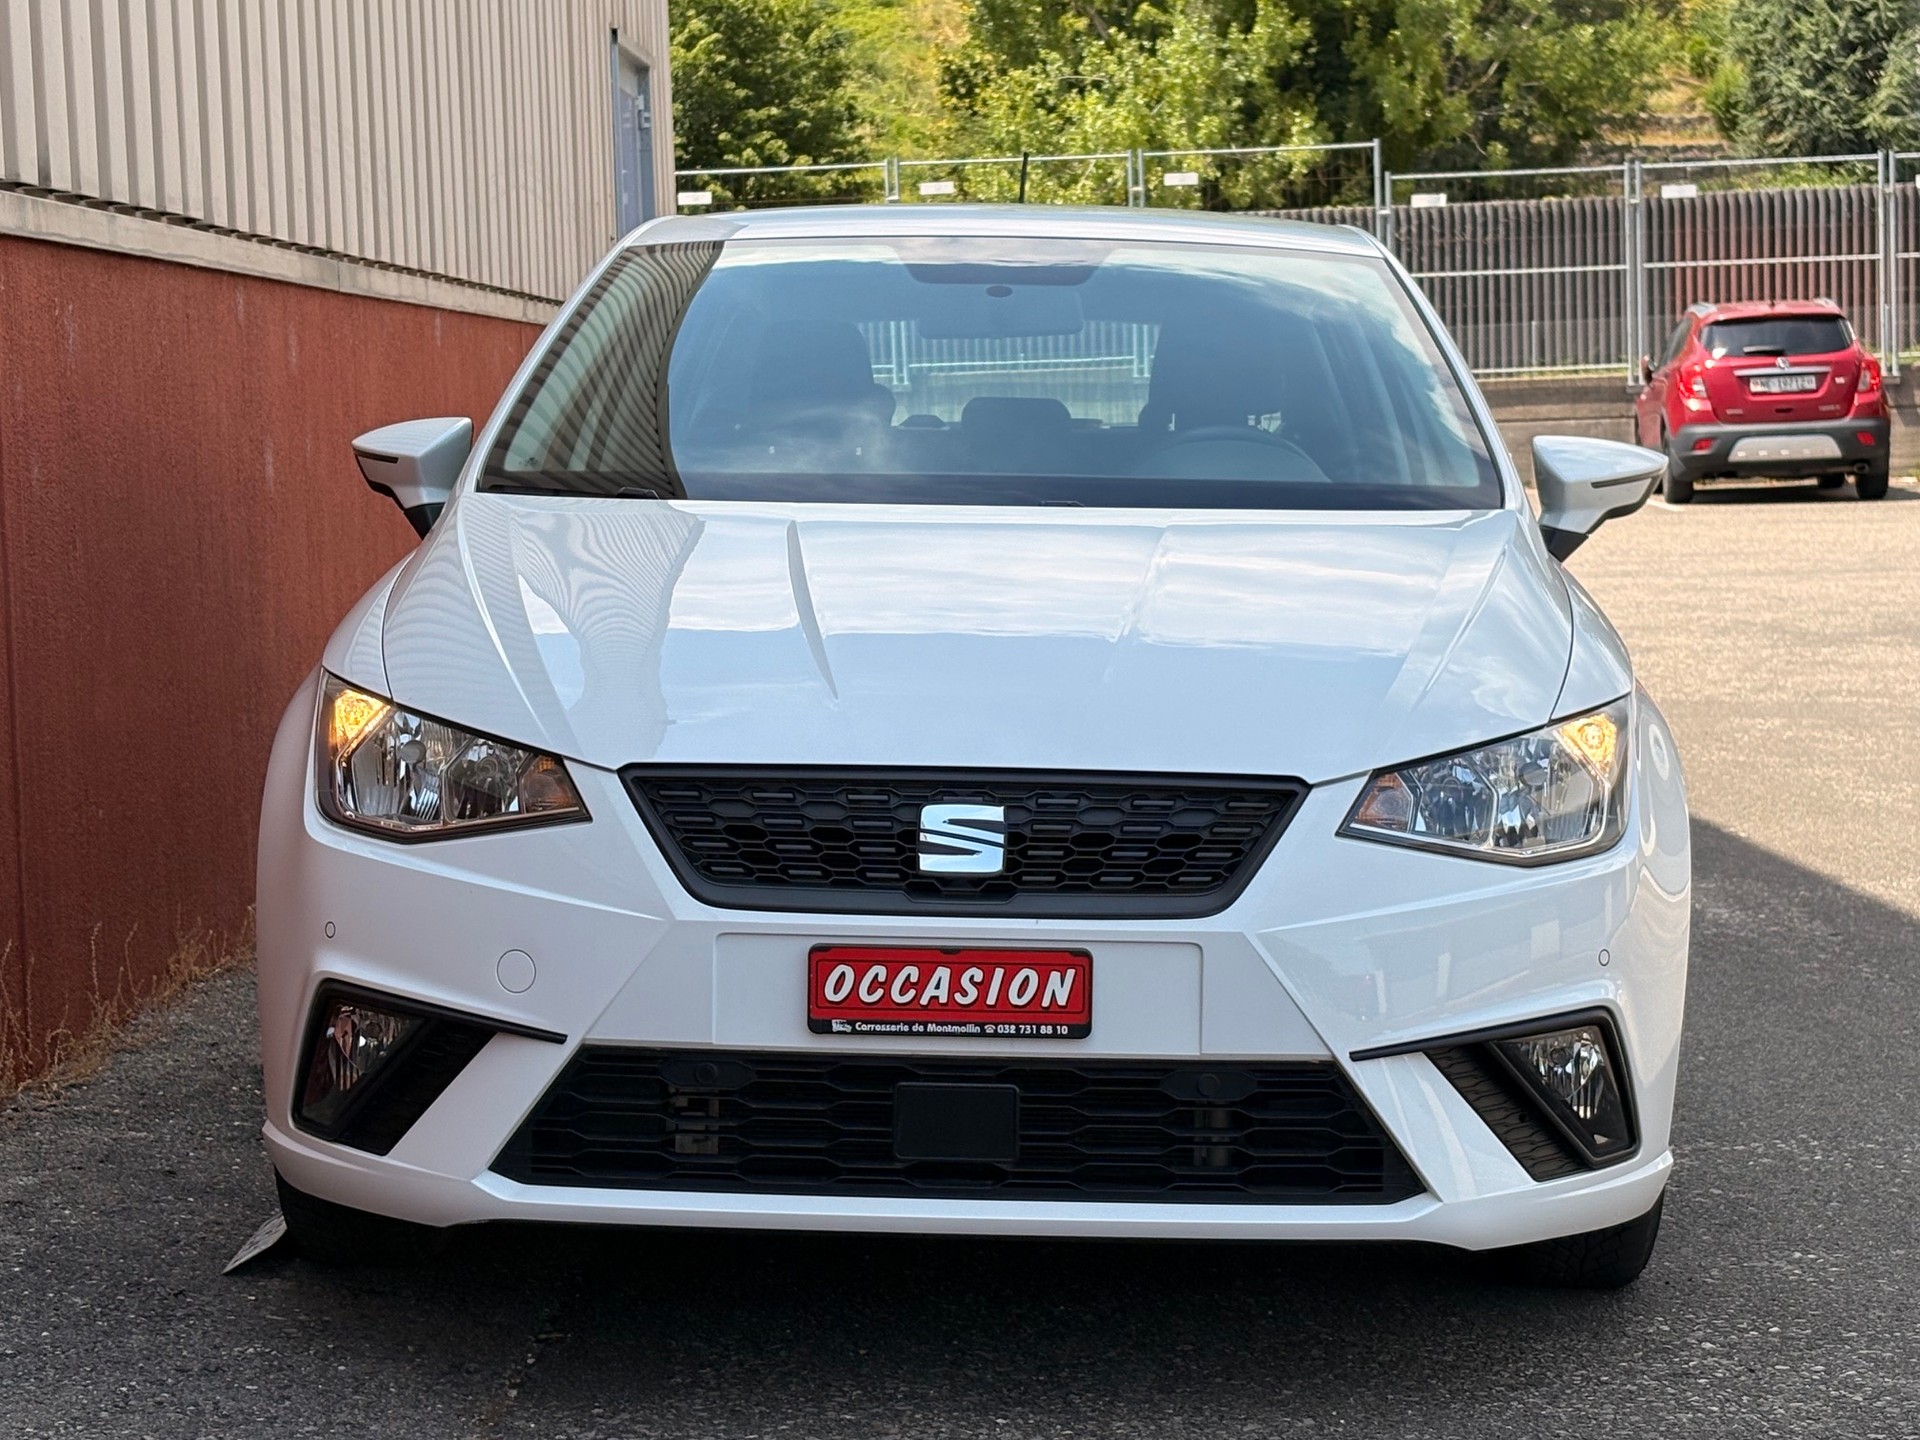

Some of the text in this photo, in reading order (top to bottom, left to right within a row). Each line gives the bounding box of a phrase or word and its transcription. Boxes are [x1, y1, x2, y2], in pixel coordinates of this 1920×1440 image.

[824, 964, 1076, 1008] OCCASION
[855, 1021, 1069, 1036] Carrosserie de Montmollin 032 731 88 10
